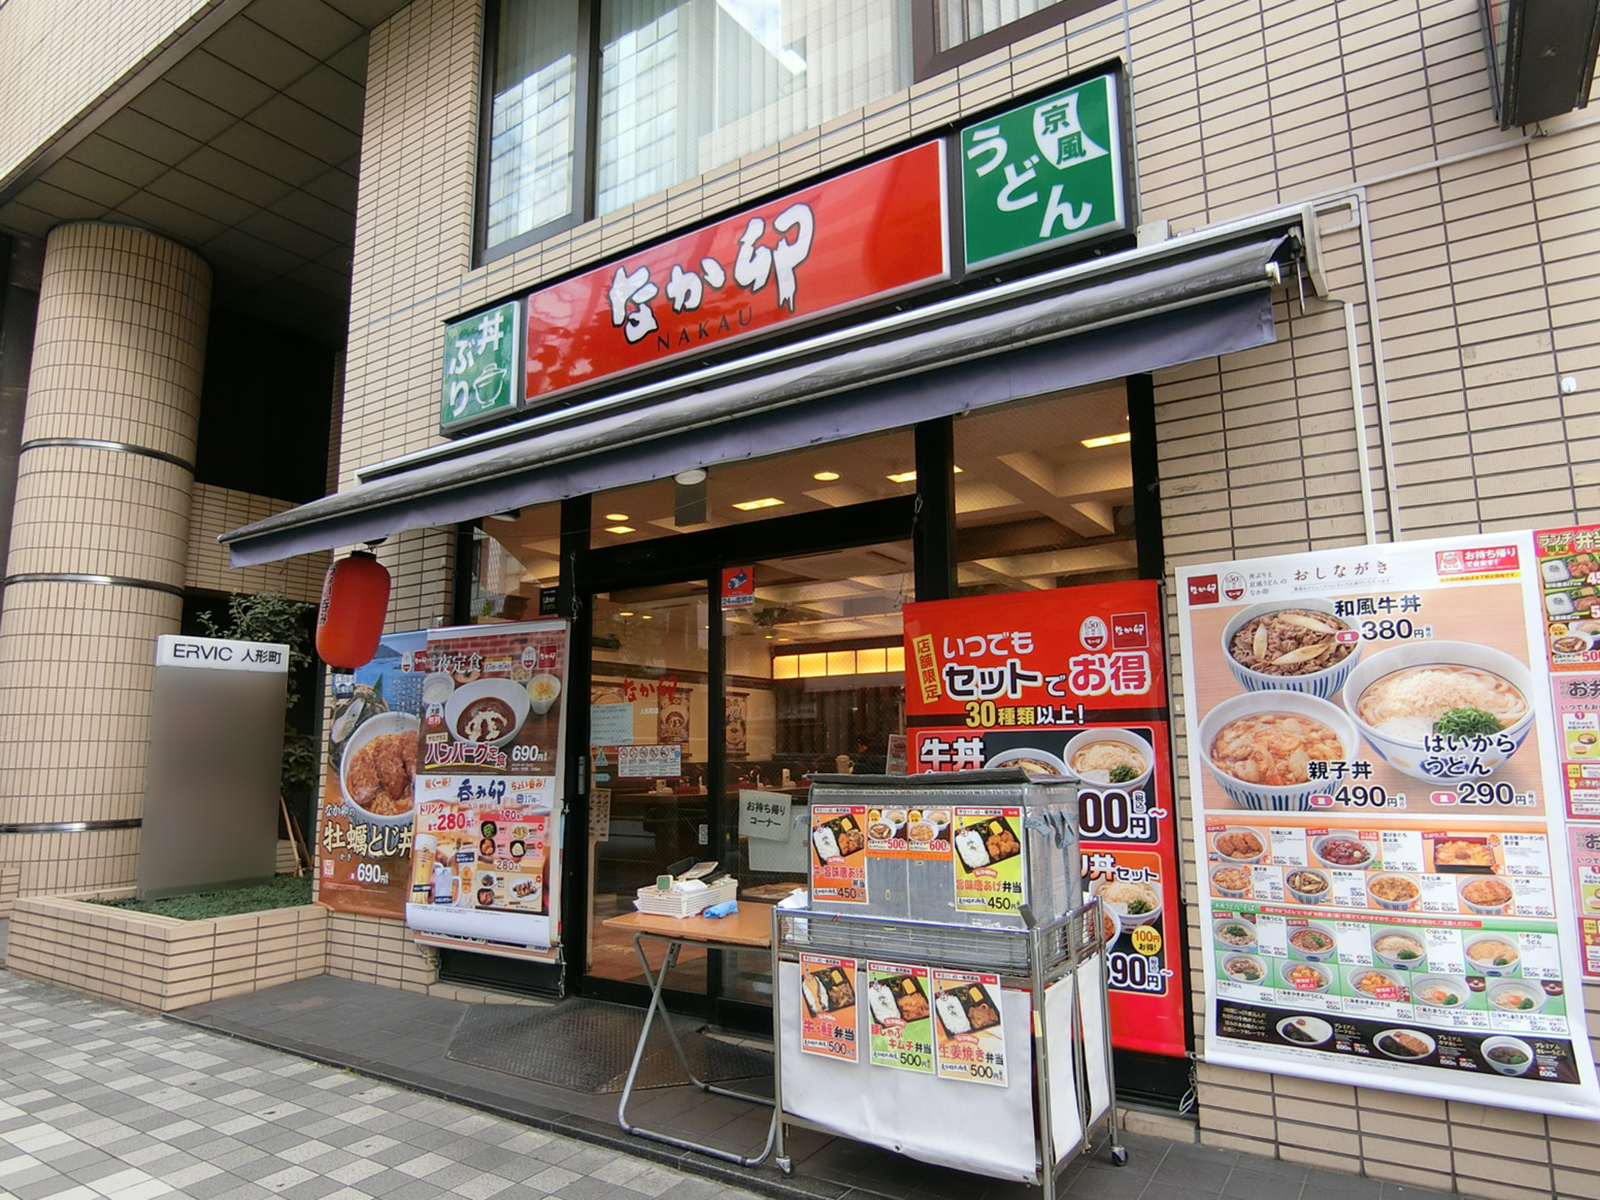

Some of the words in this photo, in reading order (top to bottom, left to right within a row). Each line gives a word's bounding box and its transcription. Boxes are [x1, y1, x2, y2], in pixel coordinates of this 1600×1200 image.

[1040, 103, 1086, 165] 京風
[967, 125, 1093, 238] うどん
[608, 202, 815, 343] なか卯
[656, 307, 752, 352] NAKAU
[1538, 532, 1572, 547] ランチ
[1464, 548, 1516, 560] お持ち帰り
[1294, 561, 1387, 581] おしながき
[1190, 583, 1217, 595] なか卯
[1335, 594, 1422, 617] 和風牛丼
[1115, 624, 1144, 635] なか卯
[1361, 618, 1424, 641] 380円
[173, 643, 233, 661] ERVIC
[241, 648, 282, 664] 人形町
[943, 631, 1034, 658] いつでも
[437, 652, 484, 674] 夜定食
[917, 638, 939, 699] 店舗限定
[944, 653, 1148, 698] セットでお得
[623, 675, 677, 703] なか卯
[965, 701, 1086, 727] 30種類以上!
[424, 741, 508, 769] ハンバーグ定食
[919, 737, 985, 770] 牛丼
[1424, 735, 1515, 753] はいから
[1308, 761, 1372, 780] 親子丼
[1424, 756, 1491, 776] うどん
[457, 778, 506, 805] 呑み卯
[1335, 786, 1398, 808] 490円
[1458, 783, 1526, 806] 290円
[747, 801, 786, 816] お持ち帰り
[750, 817, 781, 827] コーナー
[956, 880, 1022, 894] 旨味唐あげ弁当
[1134, 930, 1160, 942] 100円
[889, 1039, 932, 1054] キムチ弁当
[939, 1043, 1004, 1066] 生姜焼き弁当
